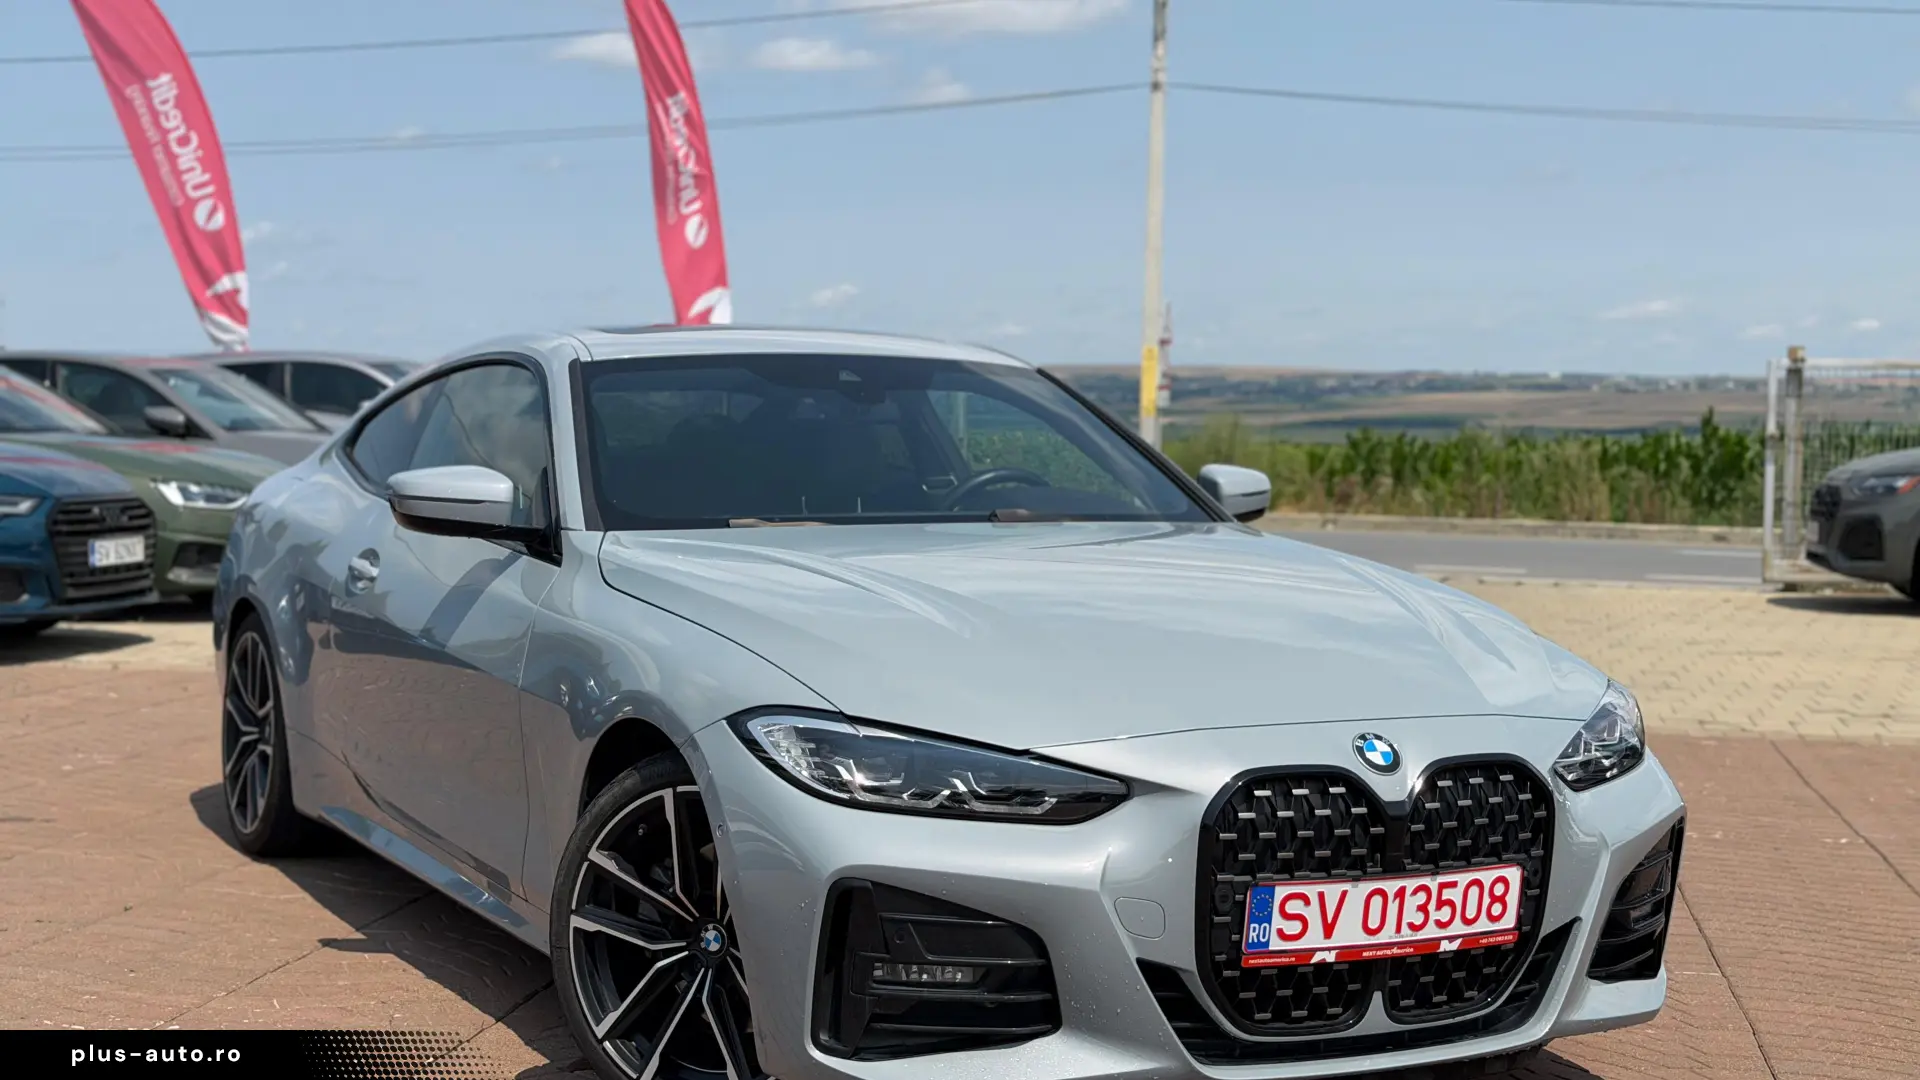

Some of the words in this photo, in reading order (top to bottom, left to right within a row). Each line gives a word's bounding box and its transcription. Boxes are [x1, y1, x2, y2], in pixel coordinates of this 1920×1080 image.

[1355, 733, 1391, 747] BMW
[1276, 889, 1349, 942] SV
[1362, 875, 1511, 937] 013508
[1248, 923, 1270, 943] RO
